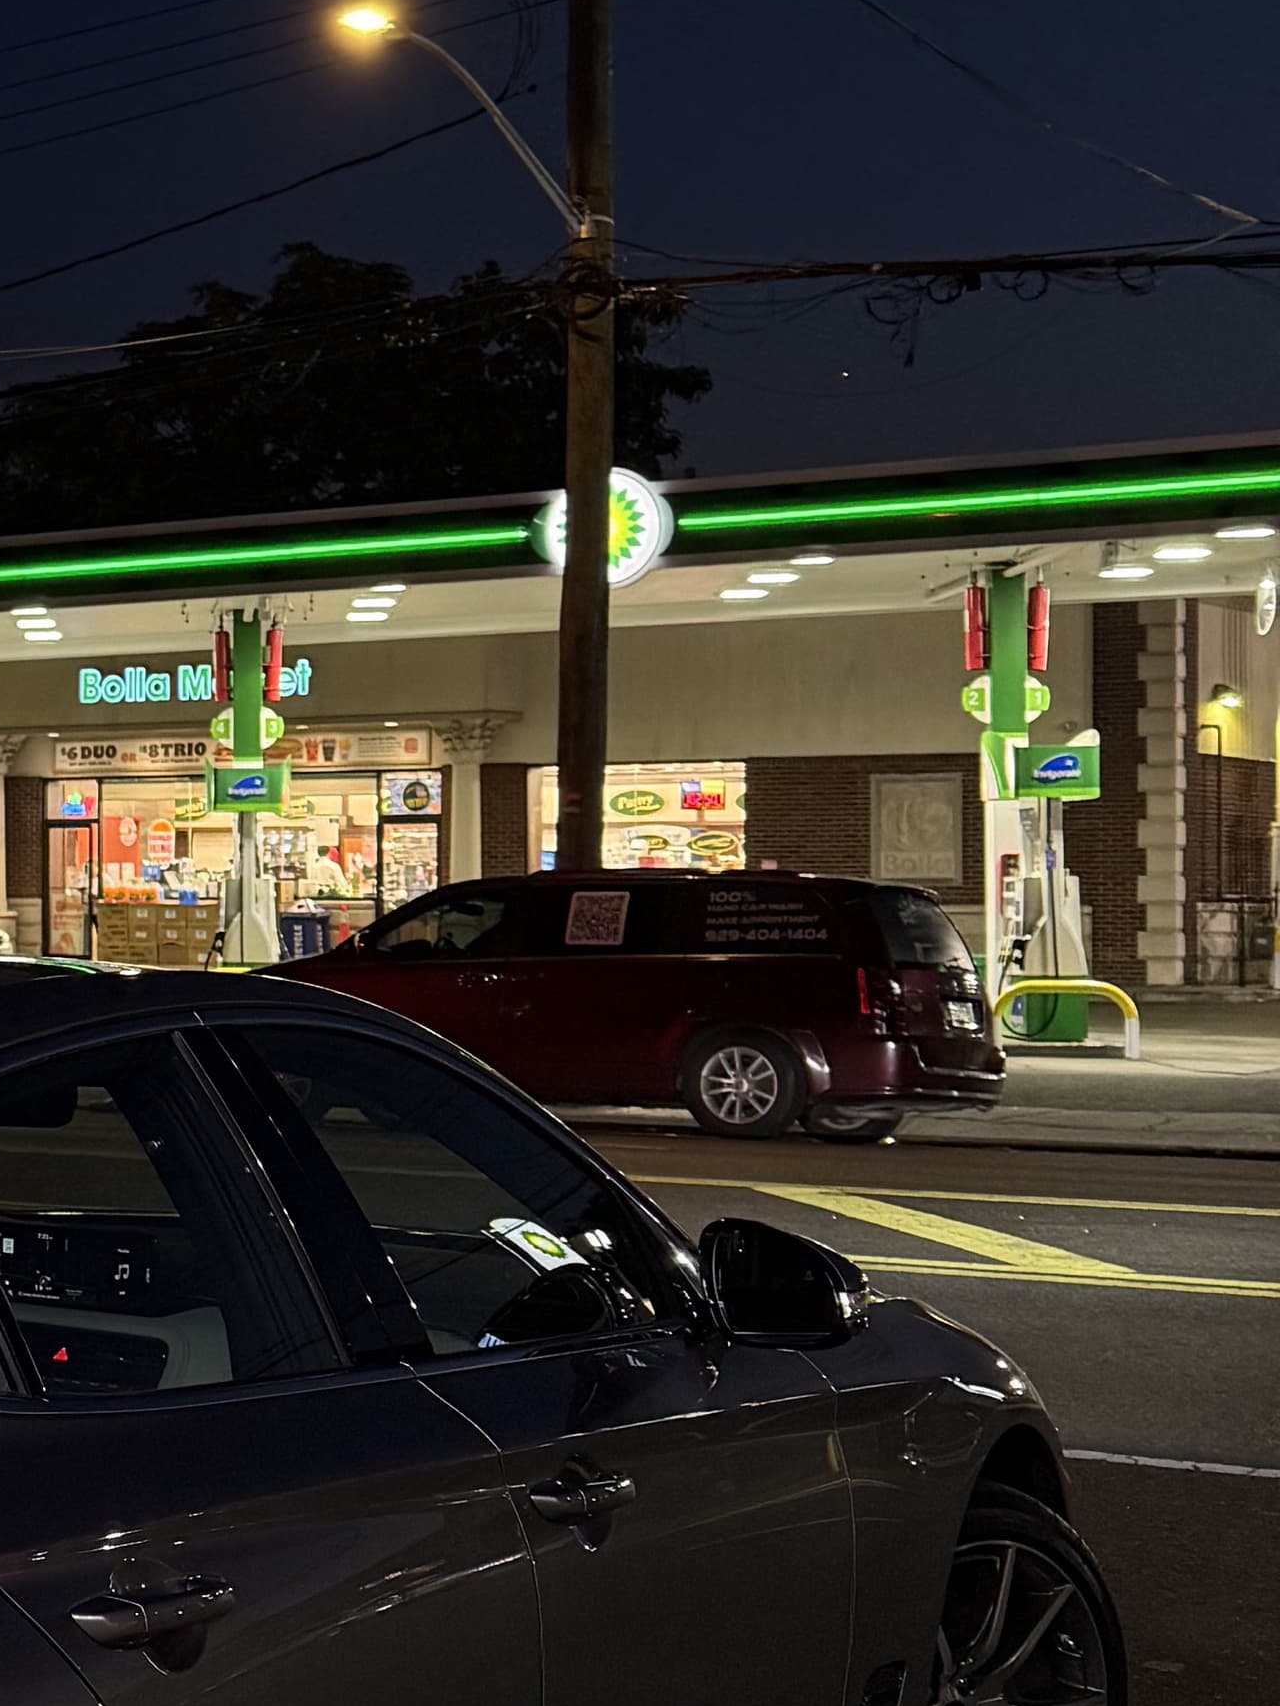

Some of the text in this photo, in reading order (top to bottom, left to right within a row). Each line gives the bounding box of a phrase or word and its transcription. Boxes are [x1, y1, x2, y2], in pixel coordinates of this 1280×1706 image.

[79, 659, 312, 704] Bolla Met
[969, 693, 979, 706] 2
[1034, 693, 1041, 705] 1
[215, 722, 225, 733] 4
[269, 722, 278, 733] 3
[80, 744, 117, 760] DUO
[160, 742, 207, 758] TRIO
